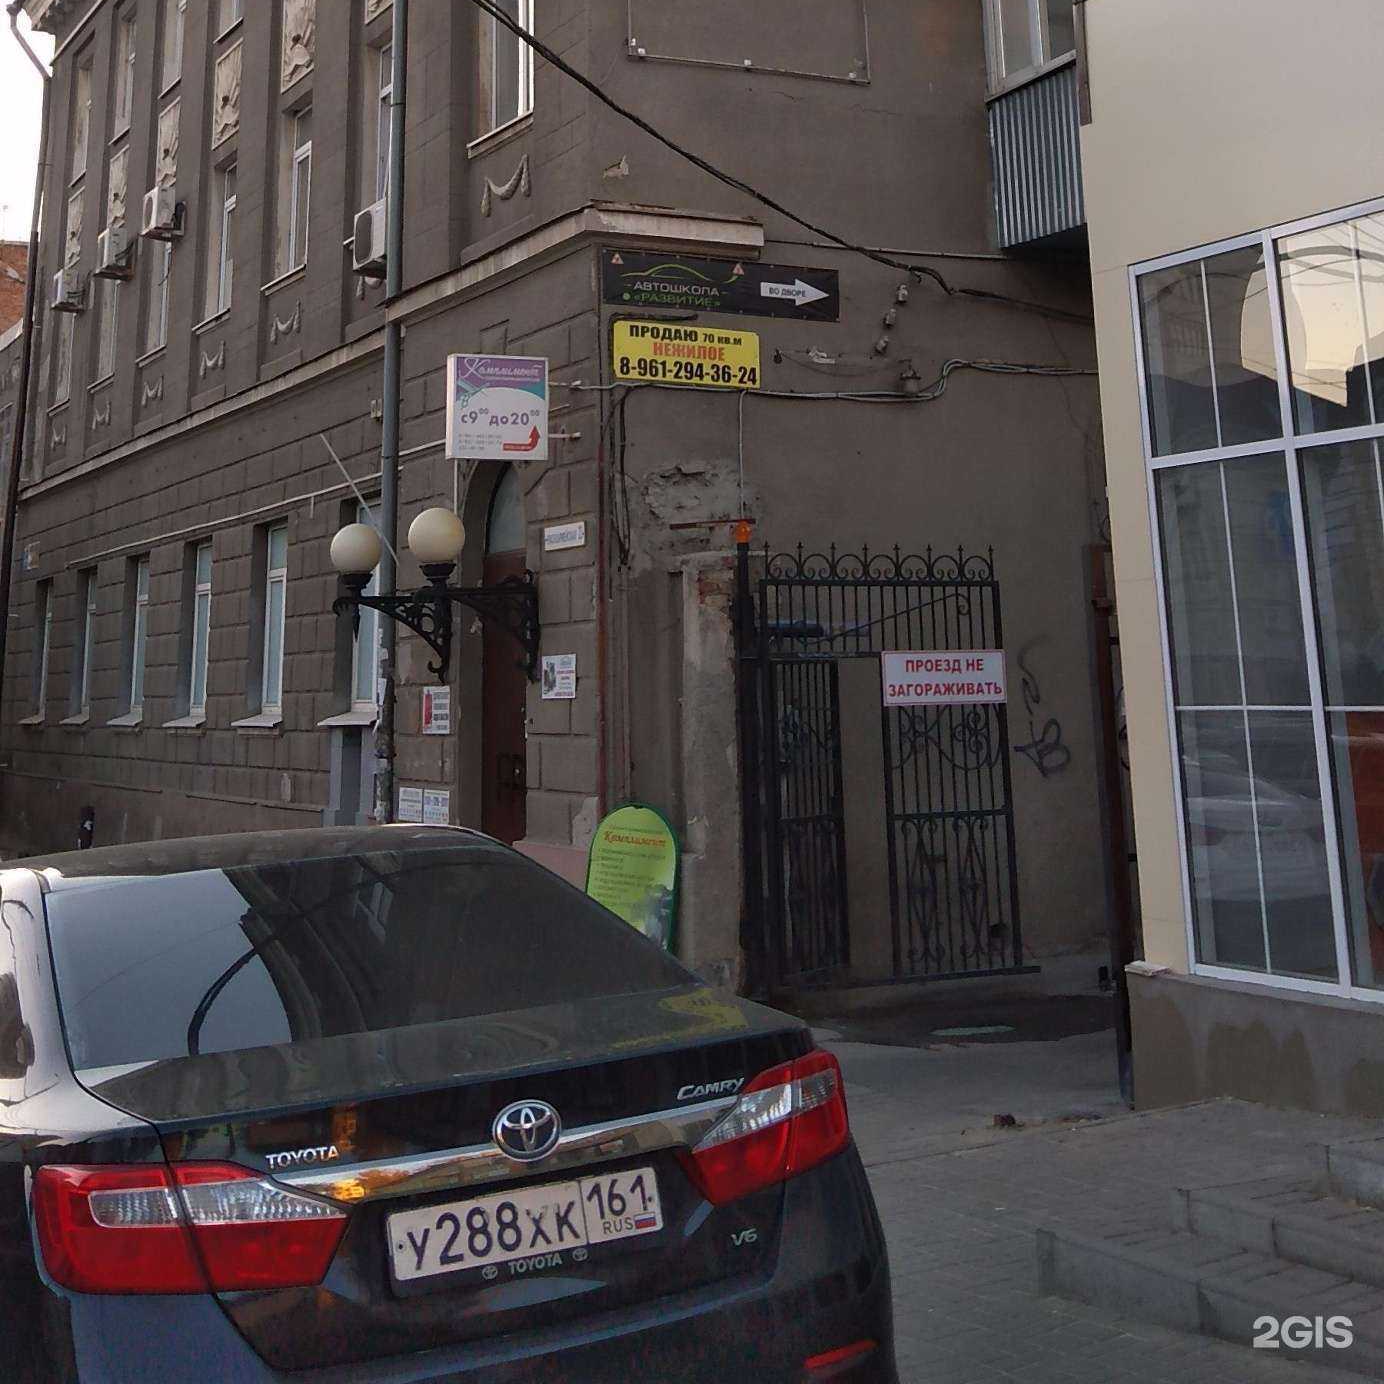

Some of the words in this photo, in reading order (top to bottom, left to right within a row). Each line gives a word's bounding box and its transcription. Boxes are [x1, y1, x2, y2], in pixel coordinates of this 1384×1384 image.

[633, 280, 720, 297] АВТОШКОЛА
[768, 287, 780, 296] ВО
[781, 288, 806, 298] ДВОРЕ
[629, 324, 699, 343] ПРОДАЮ
[702, 333, 715, 344] 70
[653, 342, 726, 362] НЕЖИЛОЕ
[620, 356, 758, 385] 8-961-294-36-24
[905, 659, 962, 674] ПРОЕЗД
[966, 658, 984, 672] НЕ
[888, 681, 1003, 698] ЗАГОРАЖИВАТЬ
[265, 1145, 340, 1169] TOYOTA
[586, 1174, 649, 1220] 161
[602, 1216, 635, 1235] RUS
[731, 1228, 758, 1246] V6
[507, 1252, 563, 1275] TOYOTA
